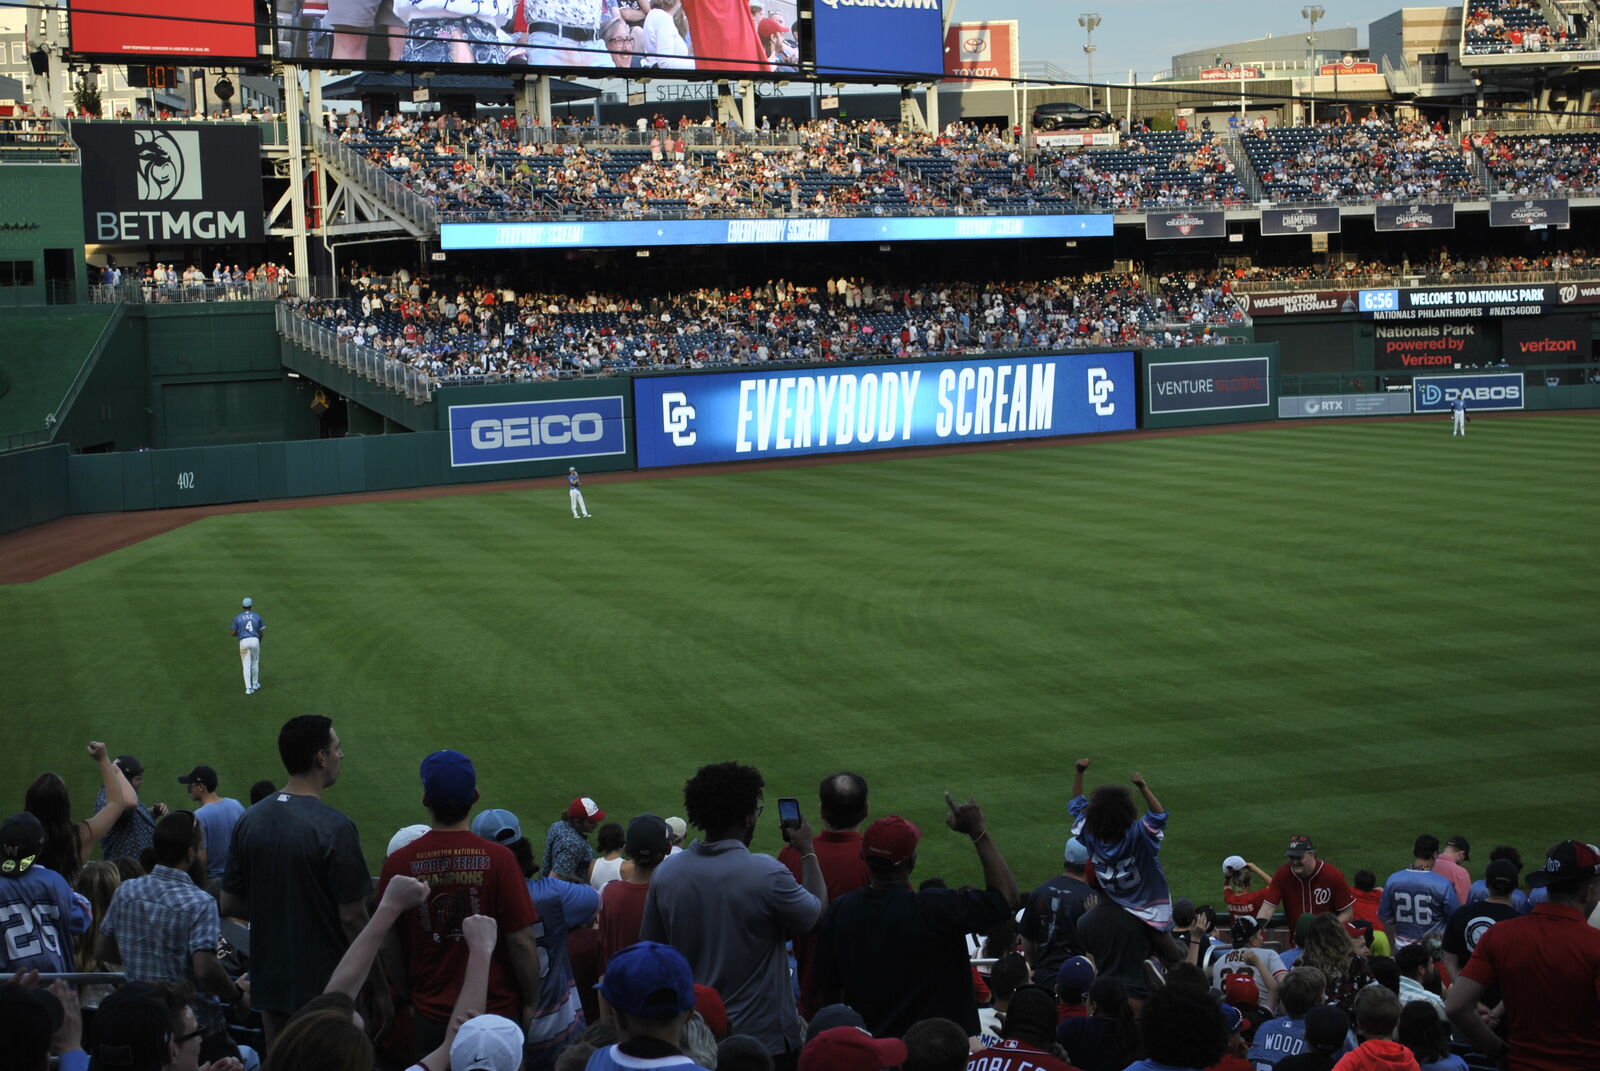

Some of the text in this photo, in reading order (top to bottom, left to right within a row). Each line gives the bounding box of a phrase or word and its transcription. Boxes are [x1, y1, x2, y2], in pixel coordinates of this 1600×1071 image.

[952, 67, 1000, 77] TOYOTA
[96, 210, 246, 241] BETMGM
[1282, 214, 1318, 226] CHAMPIONS
[1396, 215, 1433, 225] CHAMPIONS
[1253, 293, 1317, 309] WASHINGTON
[1364, 292, 1393, 309] 6:56
[1410, 288, 1544, 305] WELCOME TO NATIONALS PARK
[1284, 299, 1338, 314] NATIONALS
[1373, 306, 1541, 320] NATIONALS PHILANTHROPIES #NATS4GOOD
[1376, 323, 1475, 338] Nationals Park
[1386, 337, 1465, 352] powered by
[1519, 338, 1577, 352] verizon
[1401, 353, 1452, 366] Verizon
[1156, 375, 1264, 396] VENTURE GLOBAL
[1445, 385, 1520, 401] DABOS
[735, 362, 1056, 453] EVERYBODY SCREAM
[1321, 400, 1343, 411] RTX
[470, 412, 604, 450] GEICO
[176, 471, 195, 489] 402
[245, 620, 254, 632] 4
[410, 856, 491, 875] WORLD SERIES
[1394, 892, 1434, 926] 26
[0, 902, 62, 961] 26
[1265, 1033, 1304, 1056] WOOD
